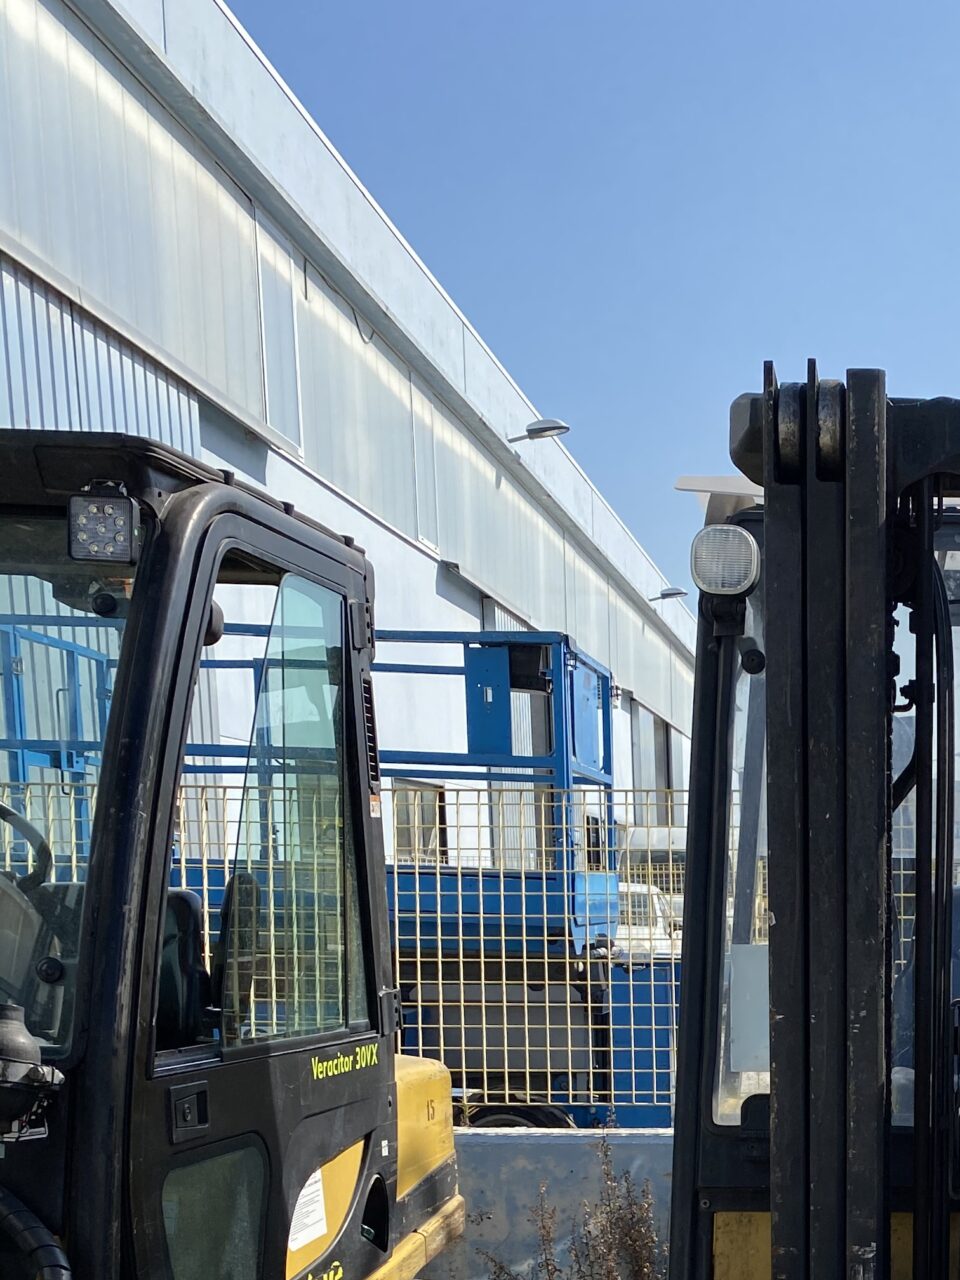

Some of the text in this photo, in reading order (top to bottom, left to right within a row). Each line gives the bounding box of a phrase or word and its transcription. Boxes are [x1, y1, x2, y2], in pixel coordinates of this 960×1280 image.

[312, 1043, 379, 1080] Veracitor 30VX
[427, 1099, 435, 1121] 15
